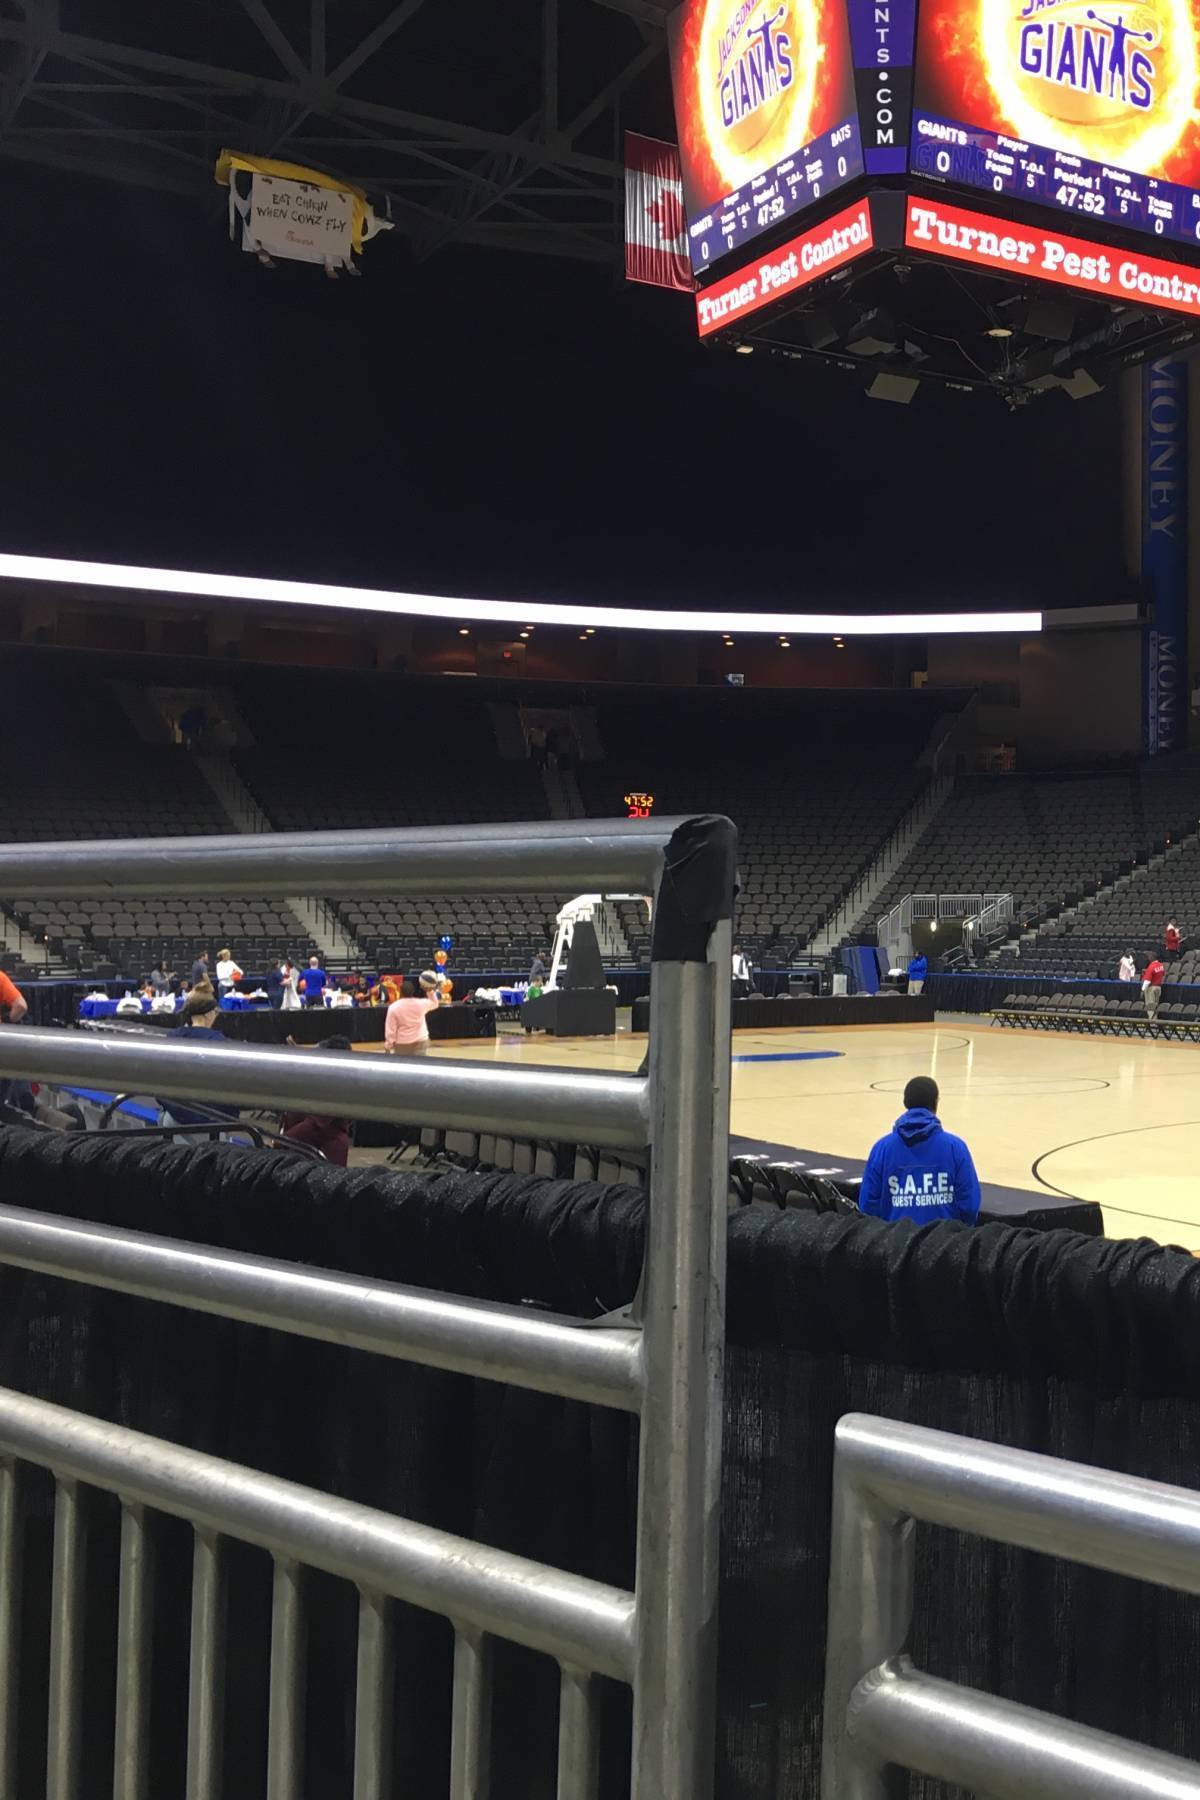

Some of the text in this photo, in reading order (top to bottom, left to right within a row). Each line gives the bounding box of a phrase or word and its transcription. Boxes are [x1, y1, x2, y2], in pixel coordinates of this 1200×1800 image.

[831, 124, 851, 147] BATS
[917, 119, 968, 145] GIANTS
[997, 135, 1029, 152] Player
[838, 157, 847, 177] 0
[937, 151, 950, 173] 0
[993, 175, 1003, 191] 0
[1026, 174, 1035, 188] 5
[1054, 168, 1101, 190] Period 1
[272, 193, 291, 206] EAT
[791, 185, 797, 199] 5
[813, 182, 820, 198] 0
[1056, 185, 1105, 215] 47:52
[1120, 200, 1128, 214] 5
[256, 207, 347, 233] WHEN COWZ FLY
[757, 196, 786, 226] 47:52
[741, 215, 748, 229] 5
[1155, 218, 1164, 234] 0
[701, 241, 709, 260] 0
[727, 235, 733, 250] 0
[910, 207, 1035, 264] Turner
[1041, 240, 1111, 283] Pest
[699, 212, 869, 326] Turner Pest Control
[1150, 356, 1177, 542] MONEY
[1157, 634, 1176, 753] MONEY
[624, 795, 654, 807] 47:52
[888, 1172, 954, 1195] S.A.F.E.
[915, 1192, 953, 1206] SERVICES
